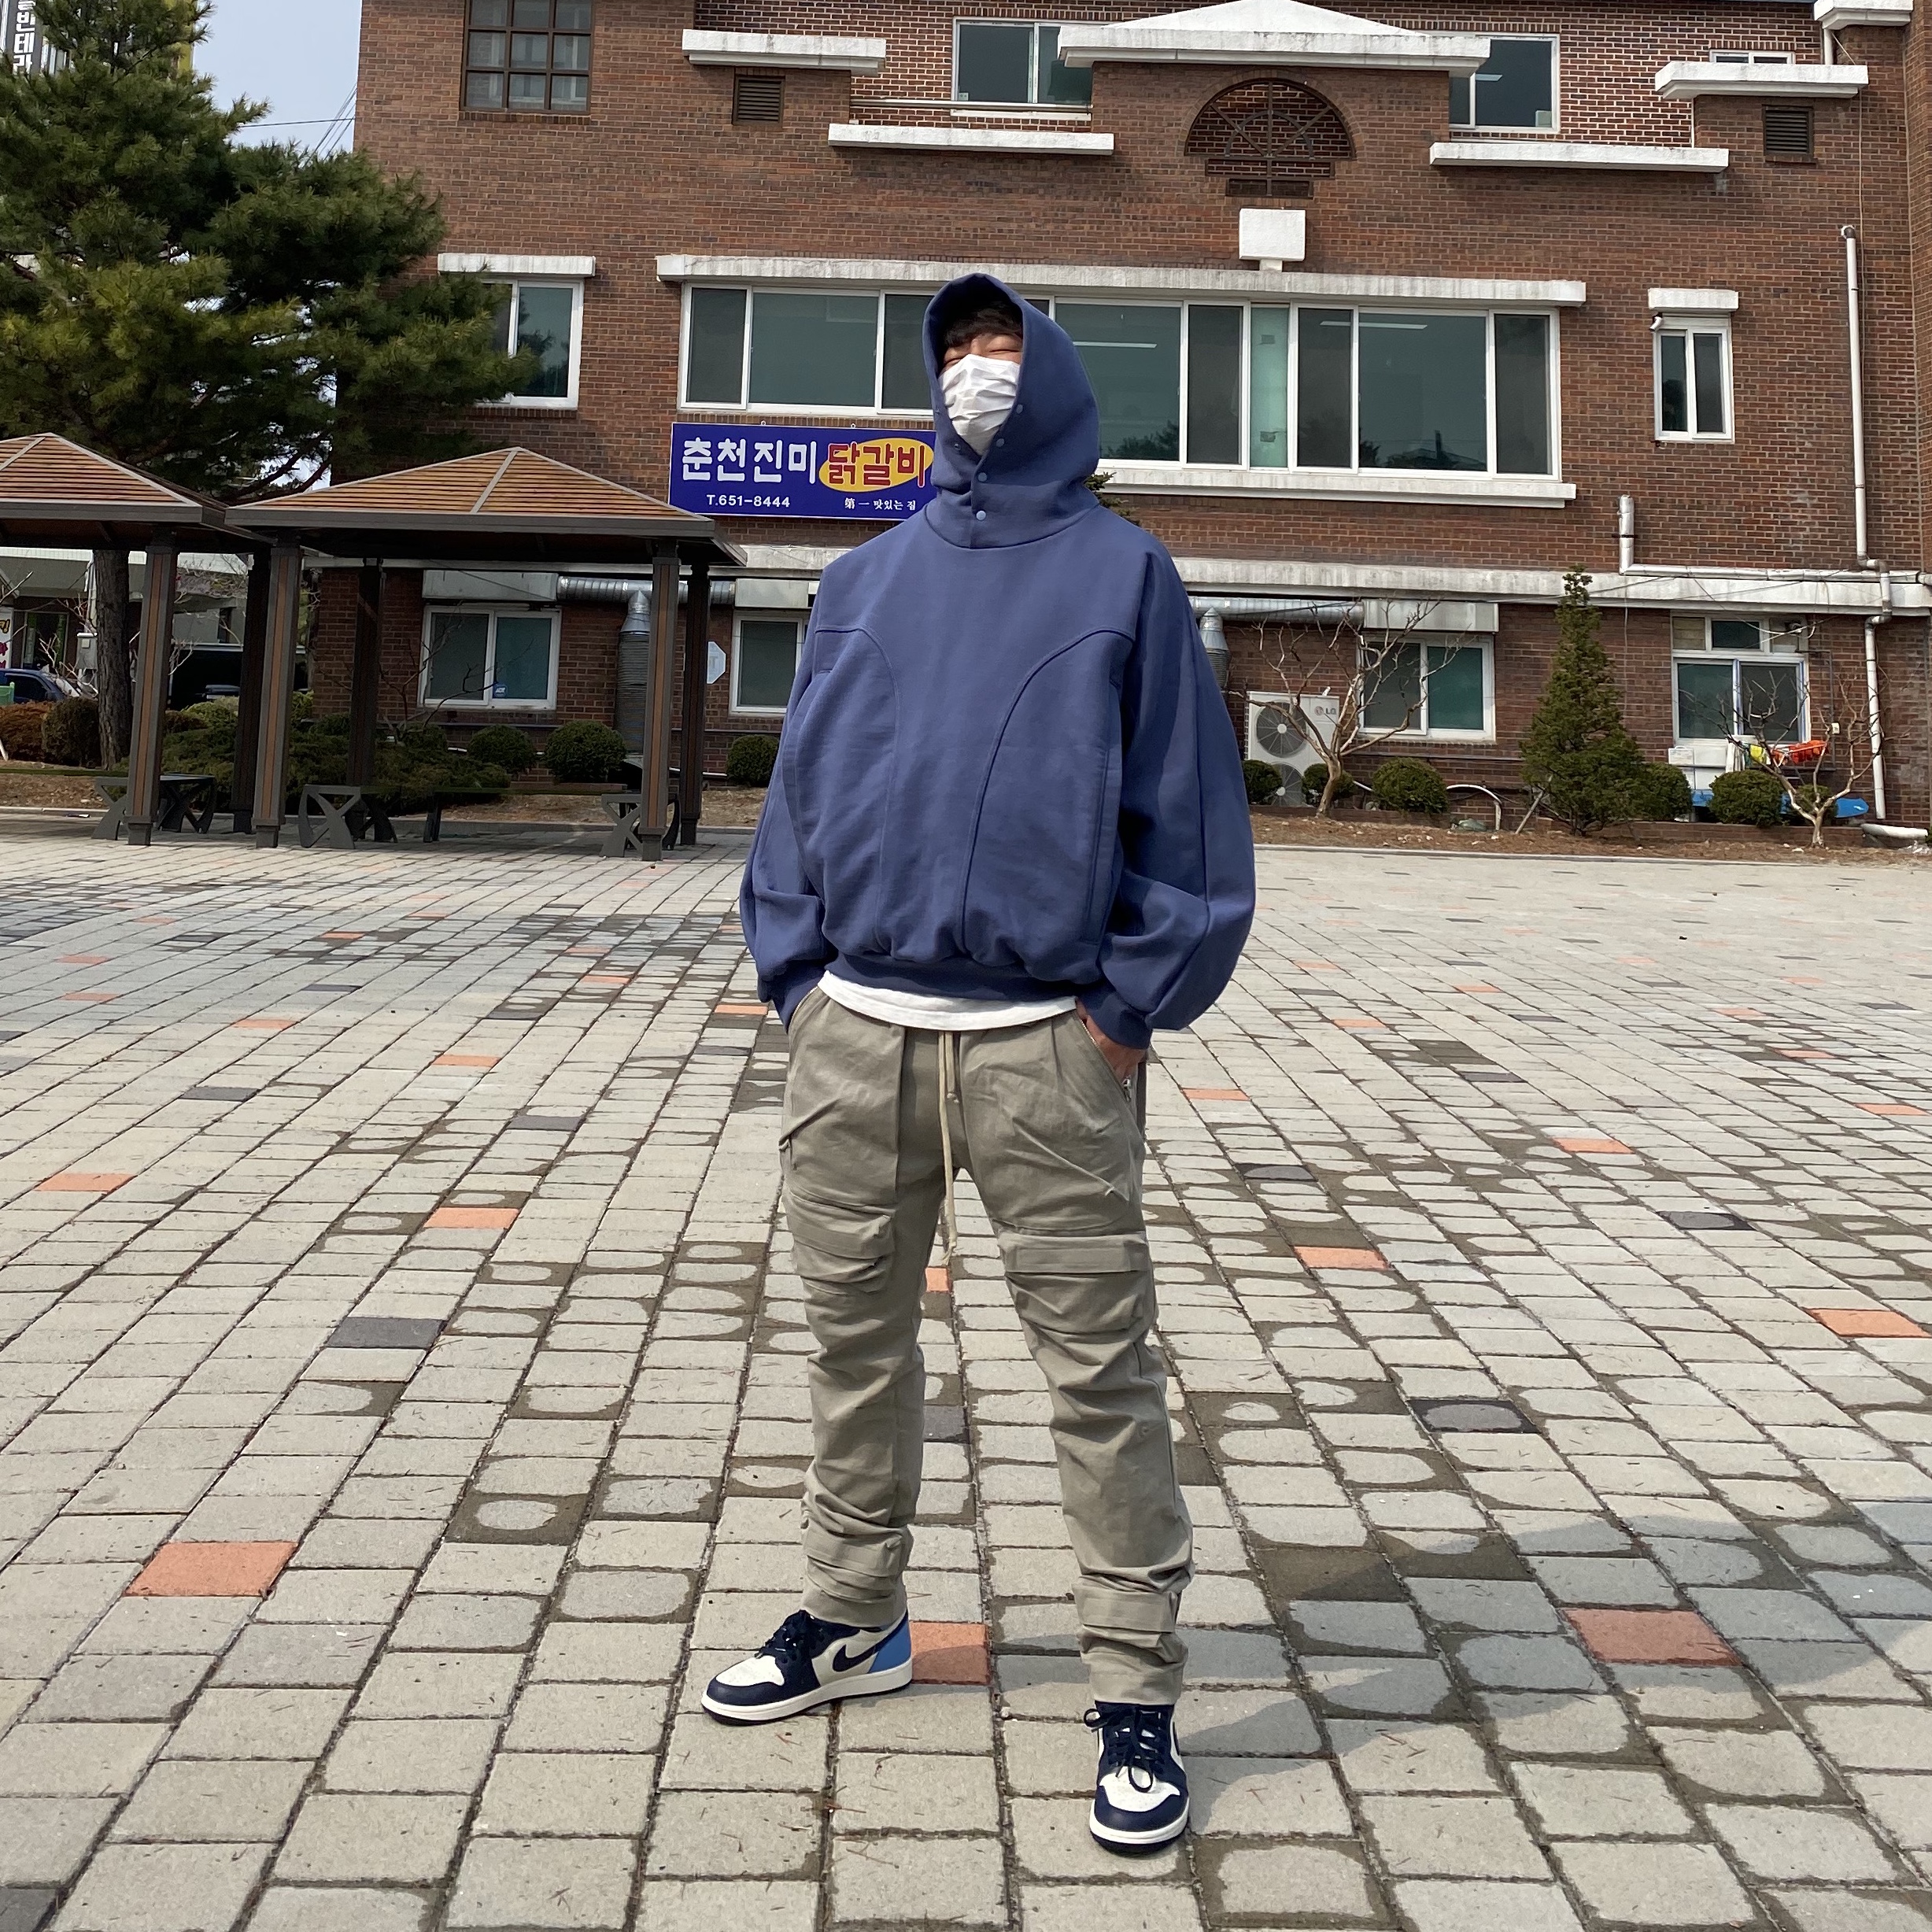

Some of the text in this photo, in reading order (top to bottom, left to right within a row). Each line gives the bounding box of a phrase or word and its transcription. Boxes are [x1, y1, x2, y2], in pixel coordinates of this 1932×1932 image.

[682, 437, 925, 488] 춘천진미 닭갈비
[707, 494, 790, 508] T.651-8444
[874, 499, 903, 511] 맛있는
[907, 500, 916, 511] 집
